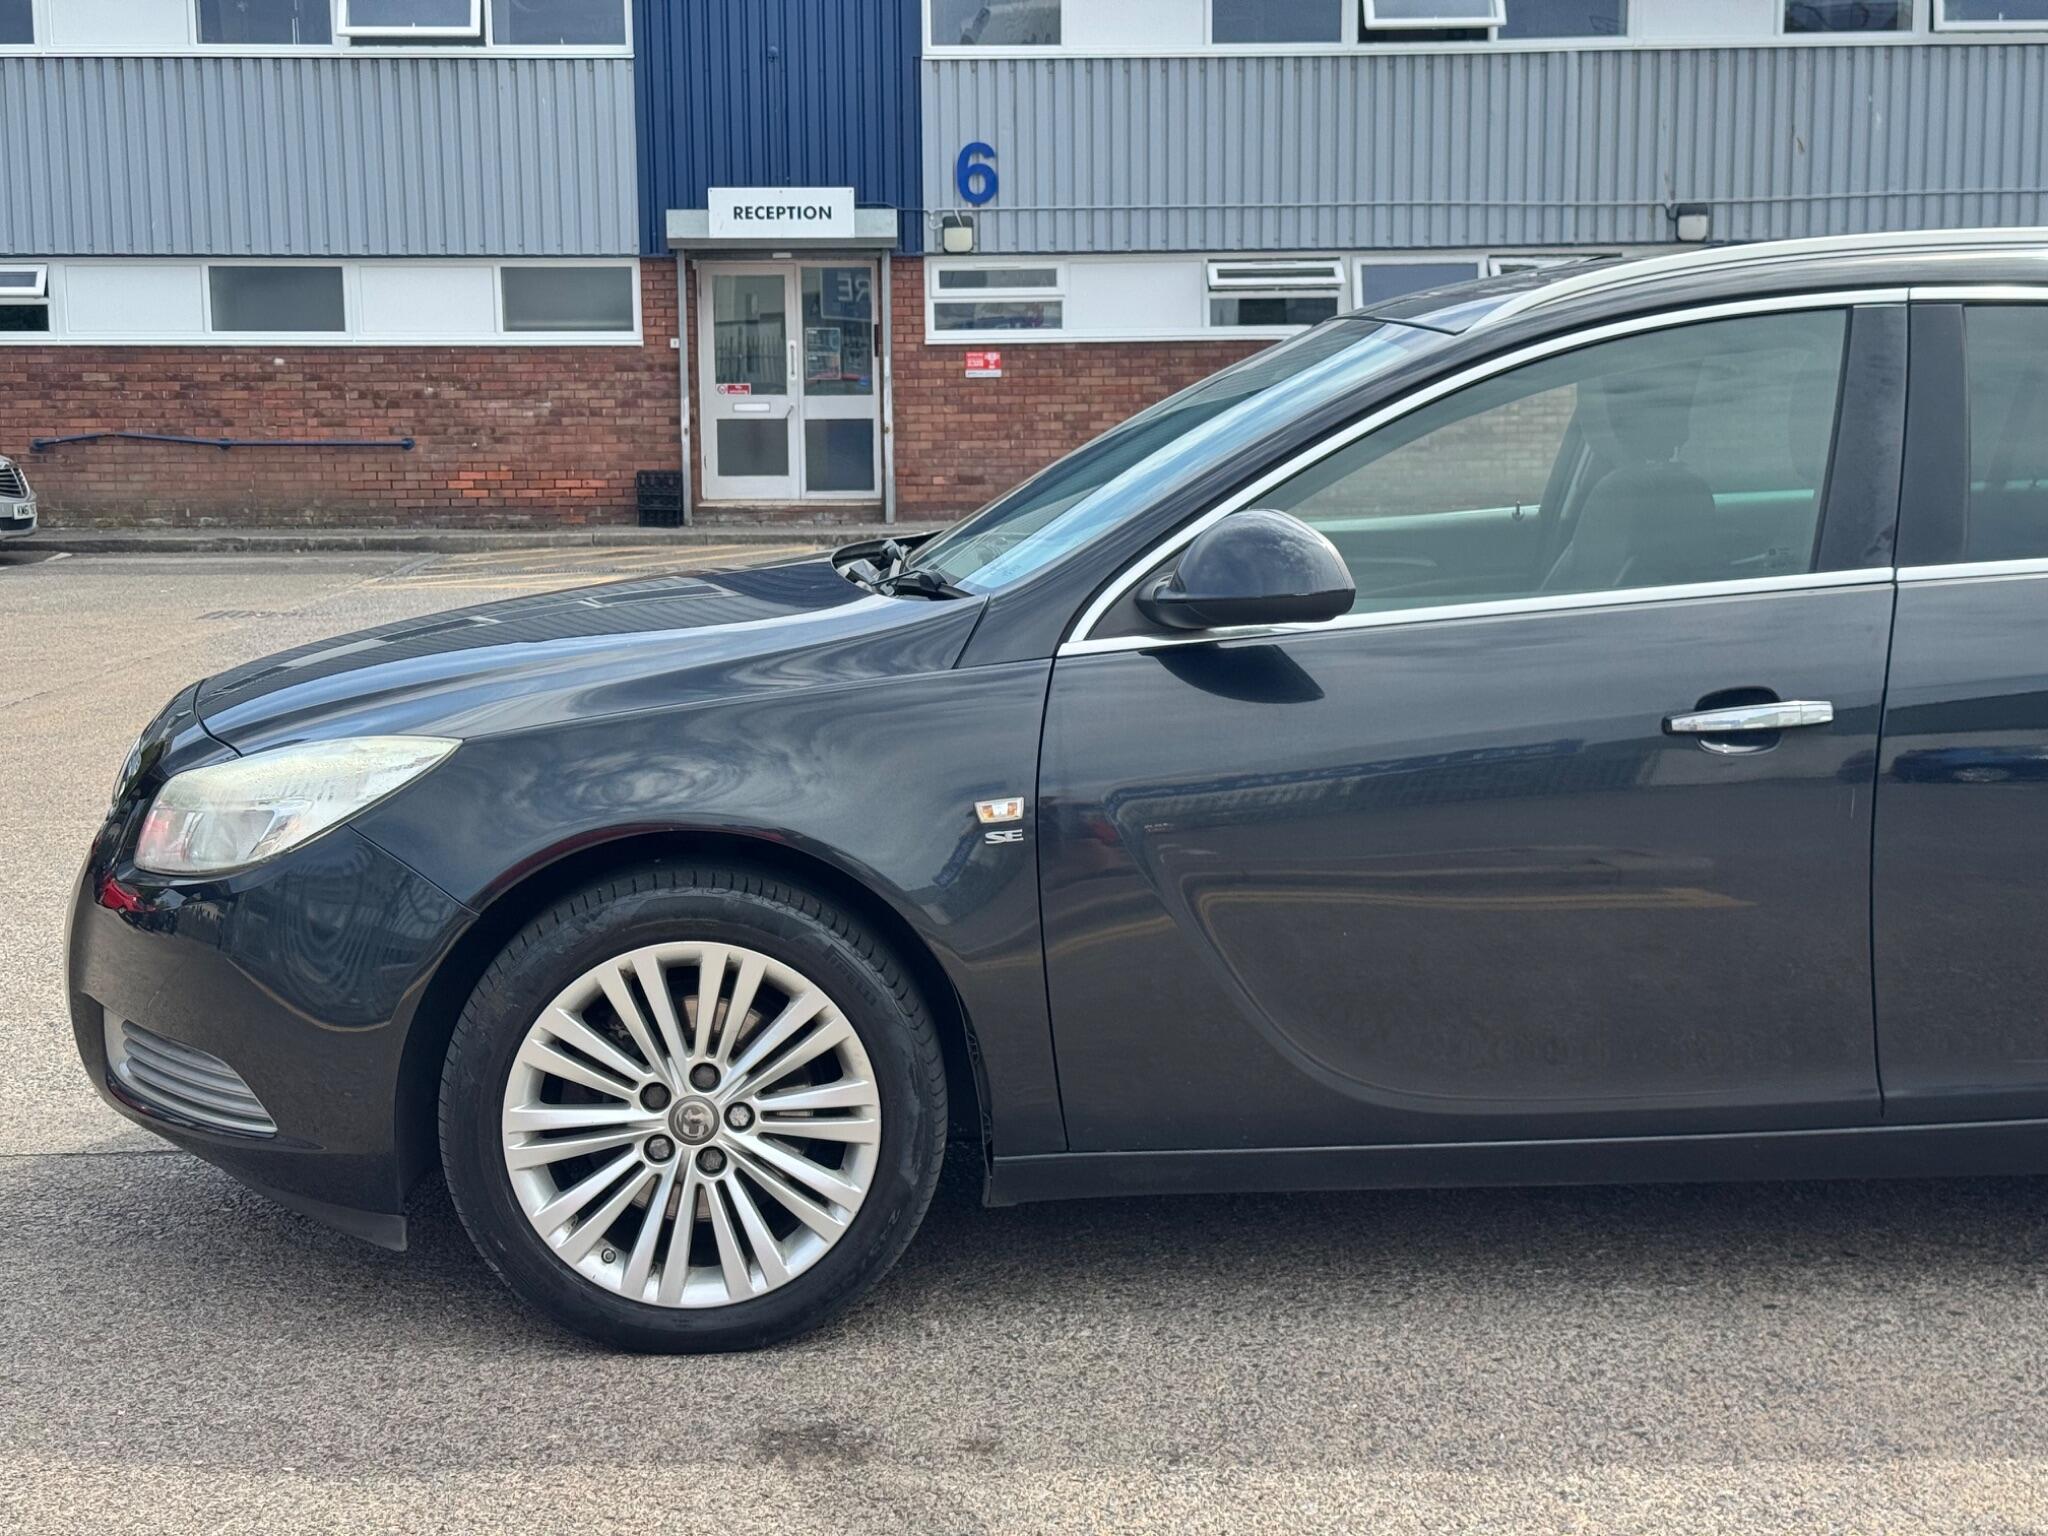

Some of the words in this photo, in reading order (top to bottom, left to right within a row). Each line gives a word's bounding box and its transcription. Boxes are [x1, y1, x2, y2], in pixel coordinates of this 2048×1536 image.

[956, 141, 998, 205] 6
[733, 205, 832, 220] RECEPTION
[985, 828, 1024, 845] SE
